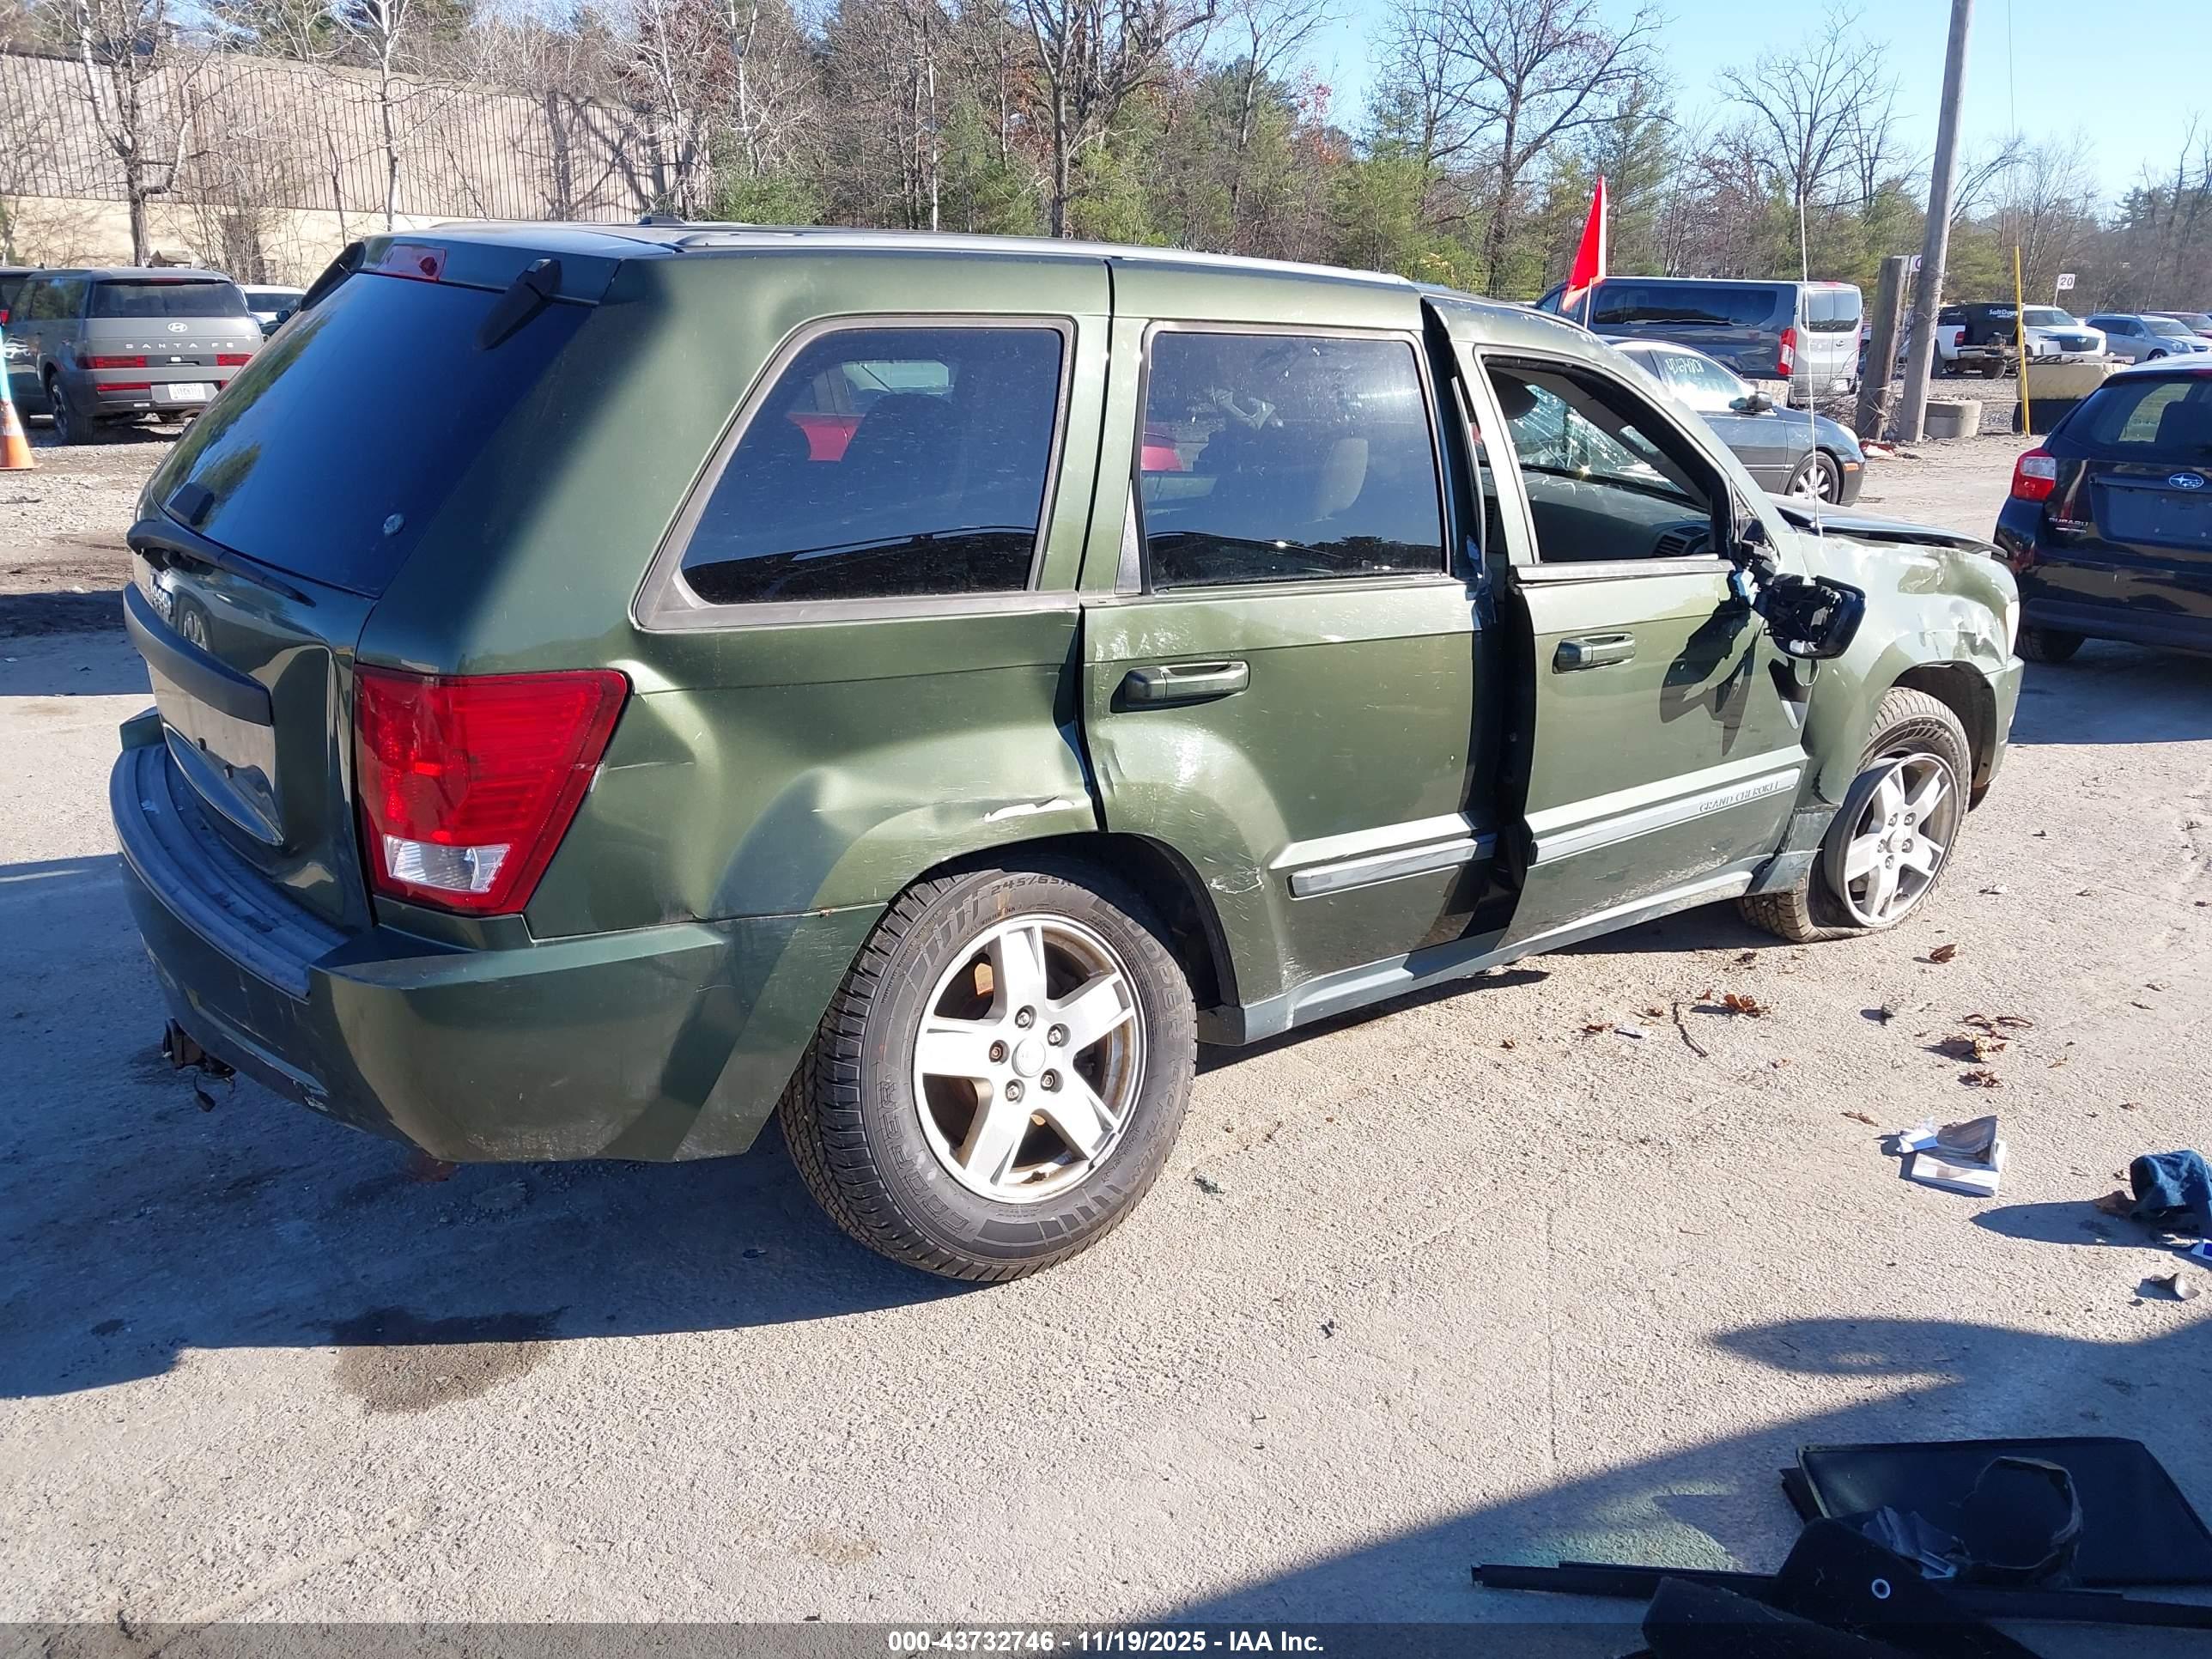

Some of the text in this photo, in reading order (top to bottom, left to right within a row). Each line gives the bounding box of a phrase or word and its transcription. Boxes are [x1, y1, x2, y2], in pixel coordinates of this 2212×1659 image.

[2060, 276, 2074, 287] 20
[1698, 781, 1779, 812] GRAND CHEROKEE
[879, 1079, 971, 1235] COOPER
